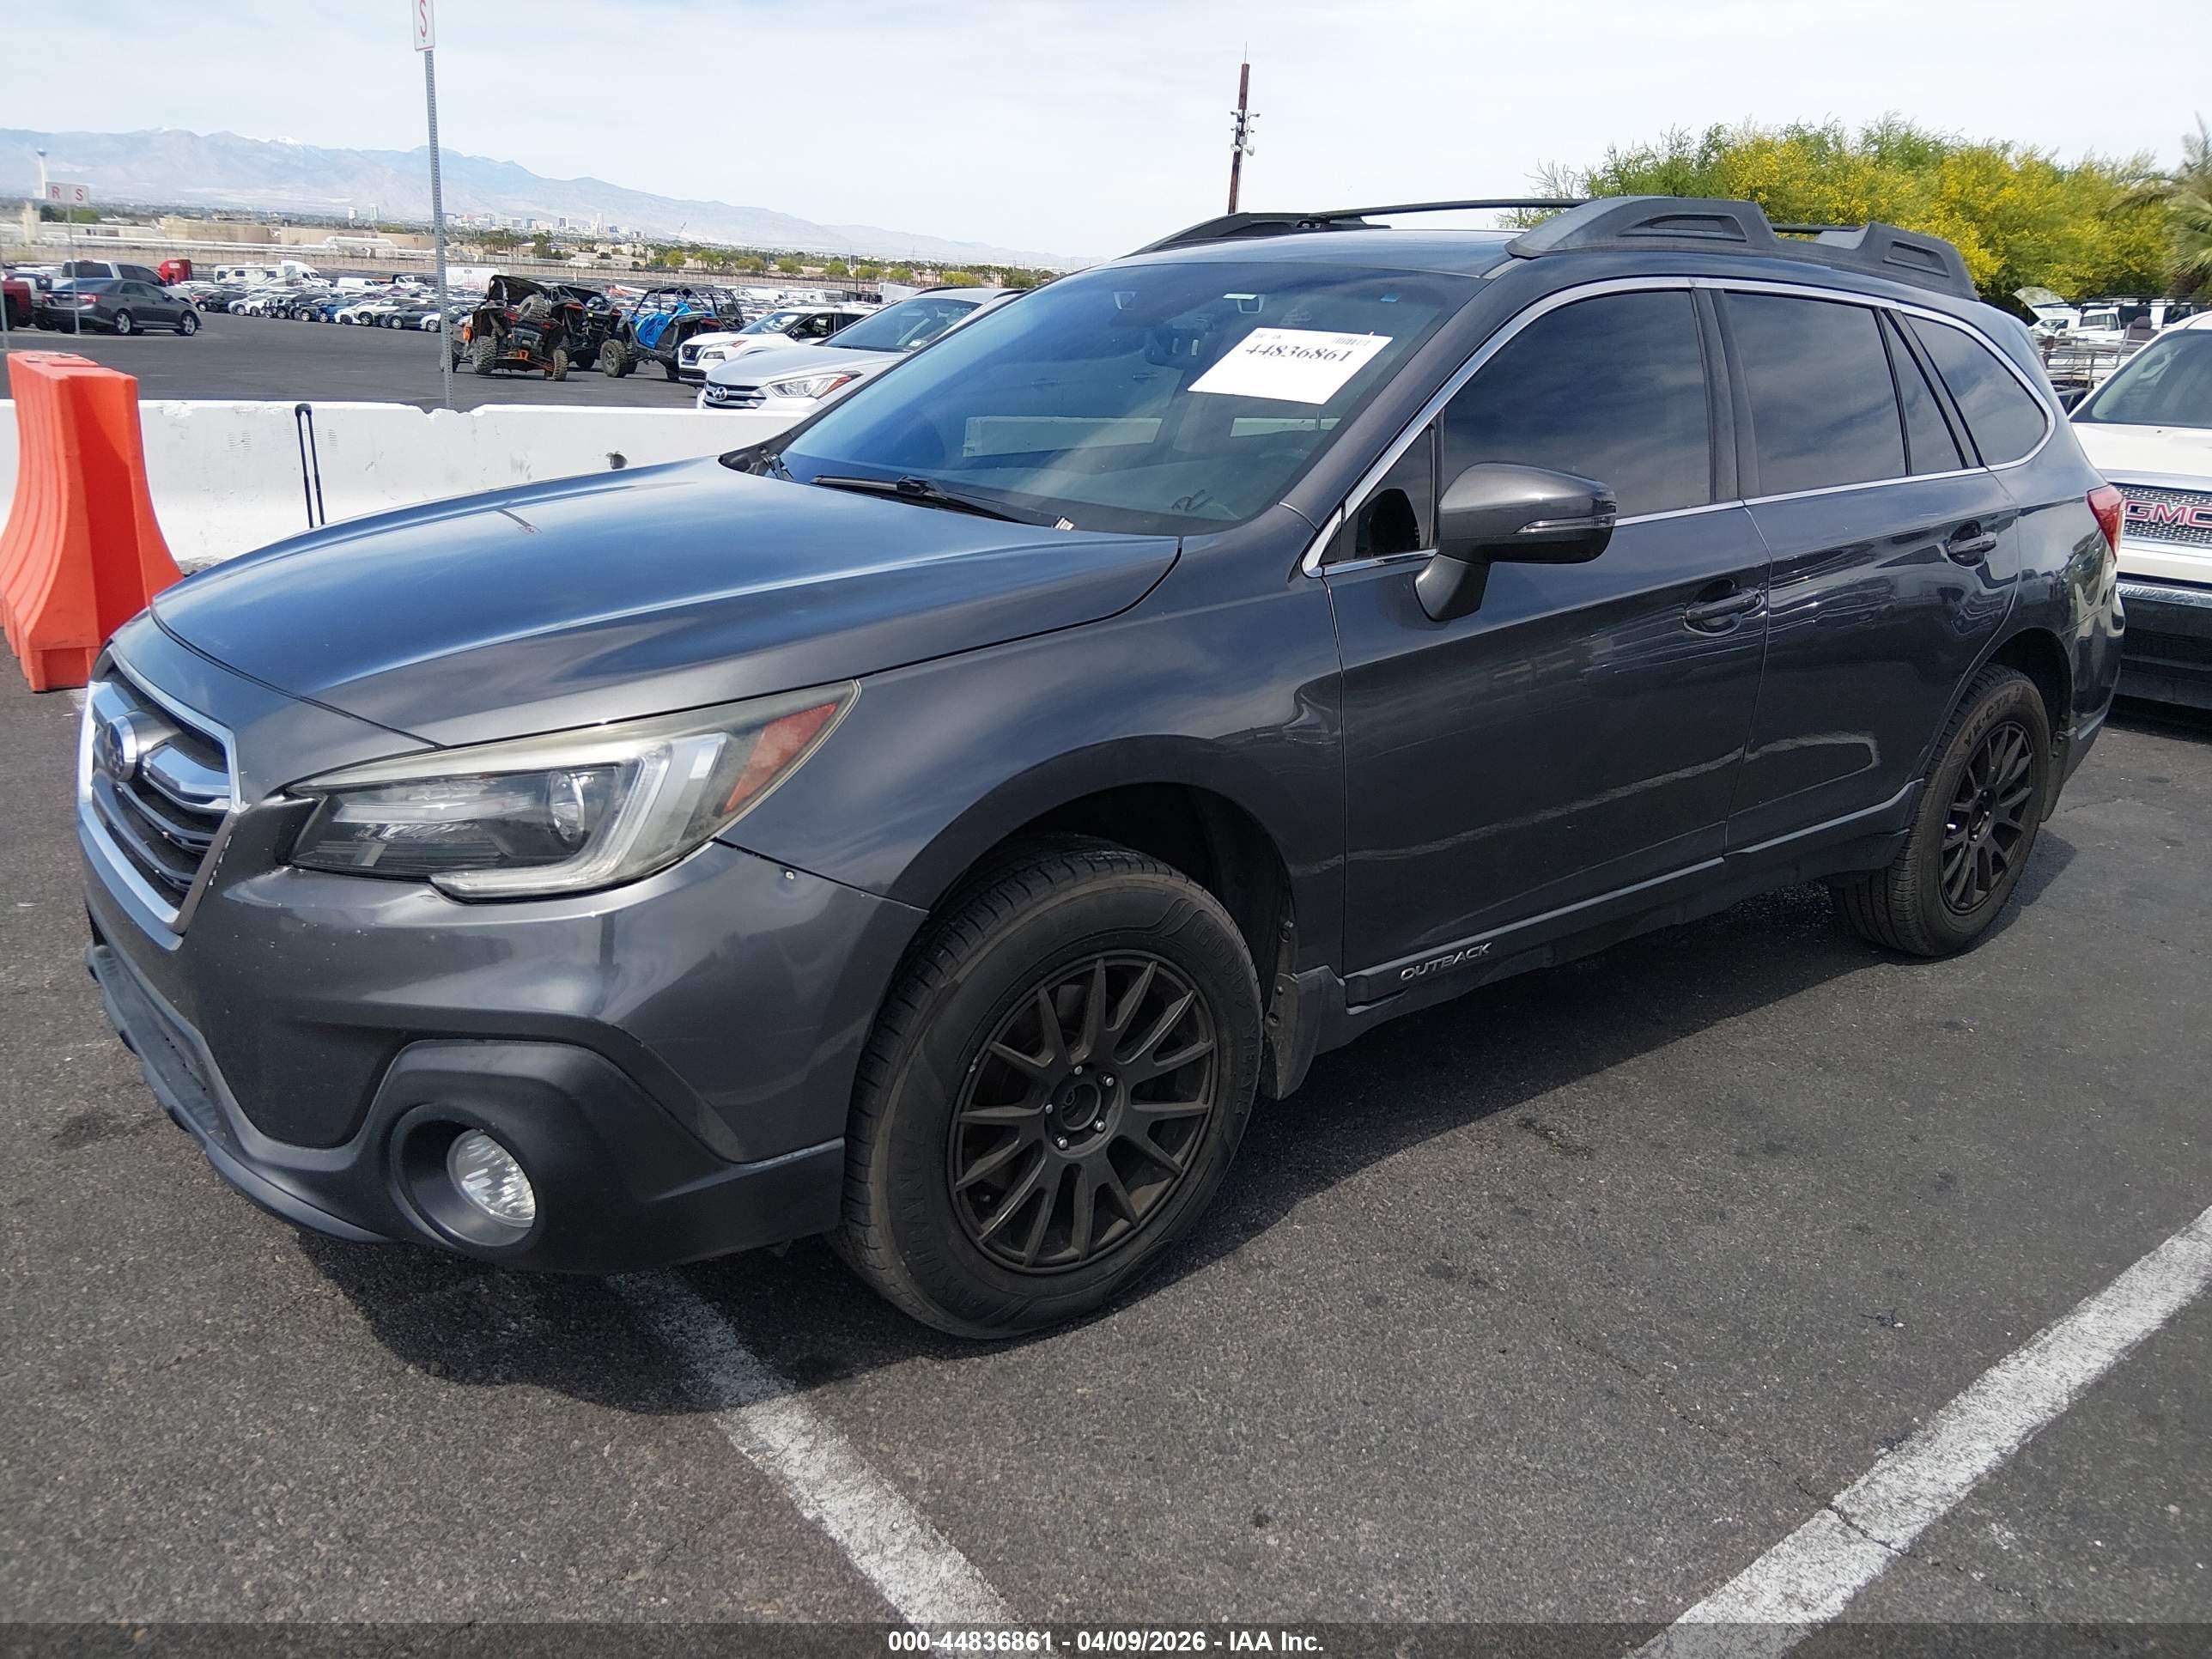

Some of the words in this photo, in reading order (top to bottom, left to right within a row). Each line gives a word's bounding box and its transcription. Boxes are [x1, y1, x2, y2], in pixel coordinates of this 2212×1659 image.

[419, 0, 428, 38] S
[51, 185, 61, 199] R
[75, 188, 84, 202] S
[1245, 343, 1353, 362] 44836861
[2125, 498, 2212, 529] GMC
[1400, 942, 1492, 981] OUTBACK
